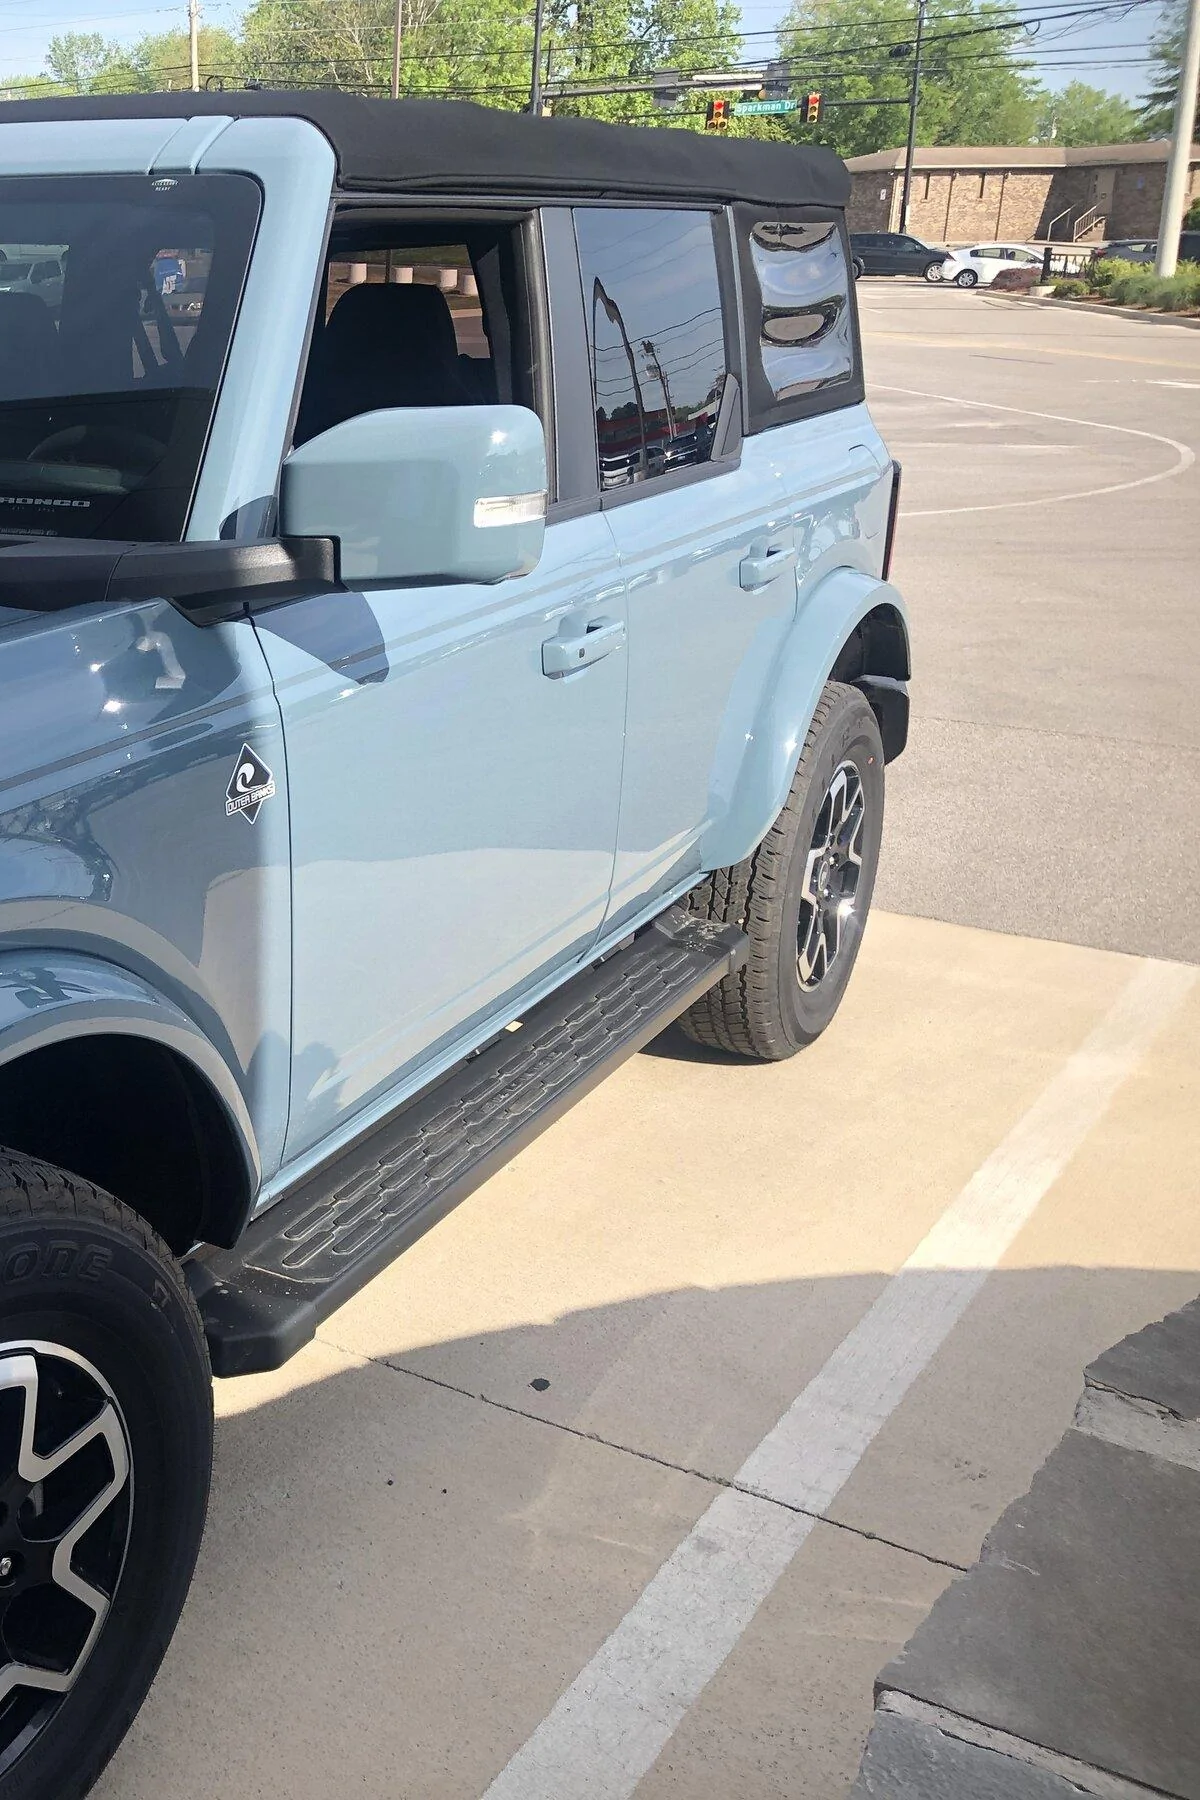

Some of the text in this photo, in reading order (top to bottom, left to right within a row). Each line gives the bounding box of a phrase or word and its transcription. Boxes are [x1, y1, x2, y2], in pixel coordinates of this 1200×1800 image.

[737, 102, 794, 113] Sparkman Dr
[228, 784, 274, 812] OUTER BANKS
